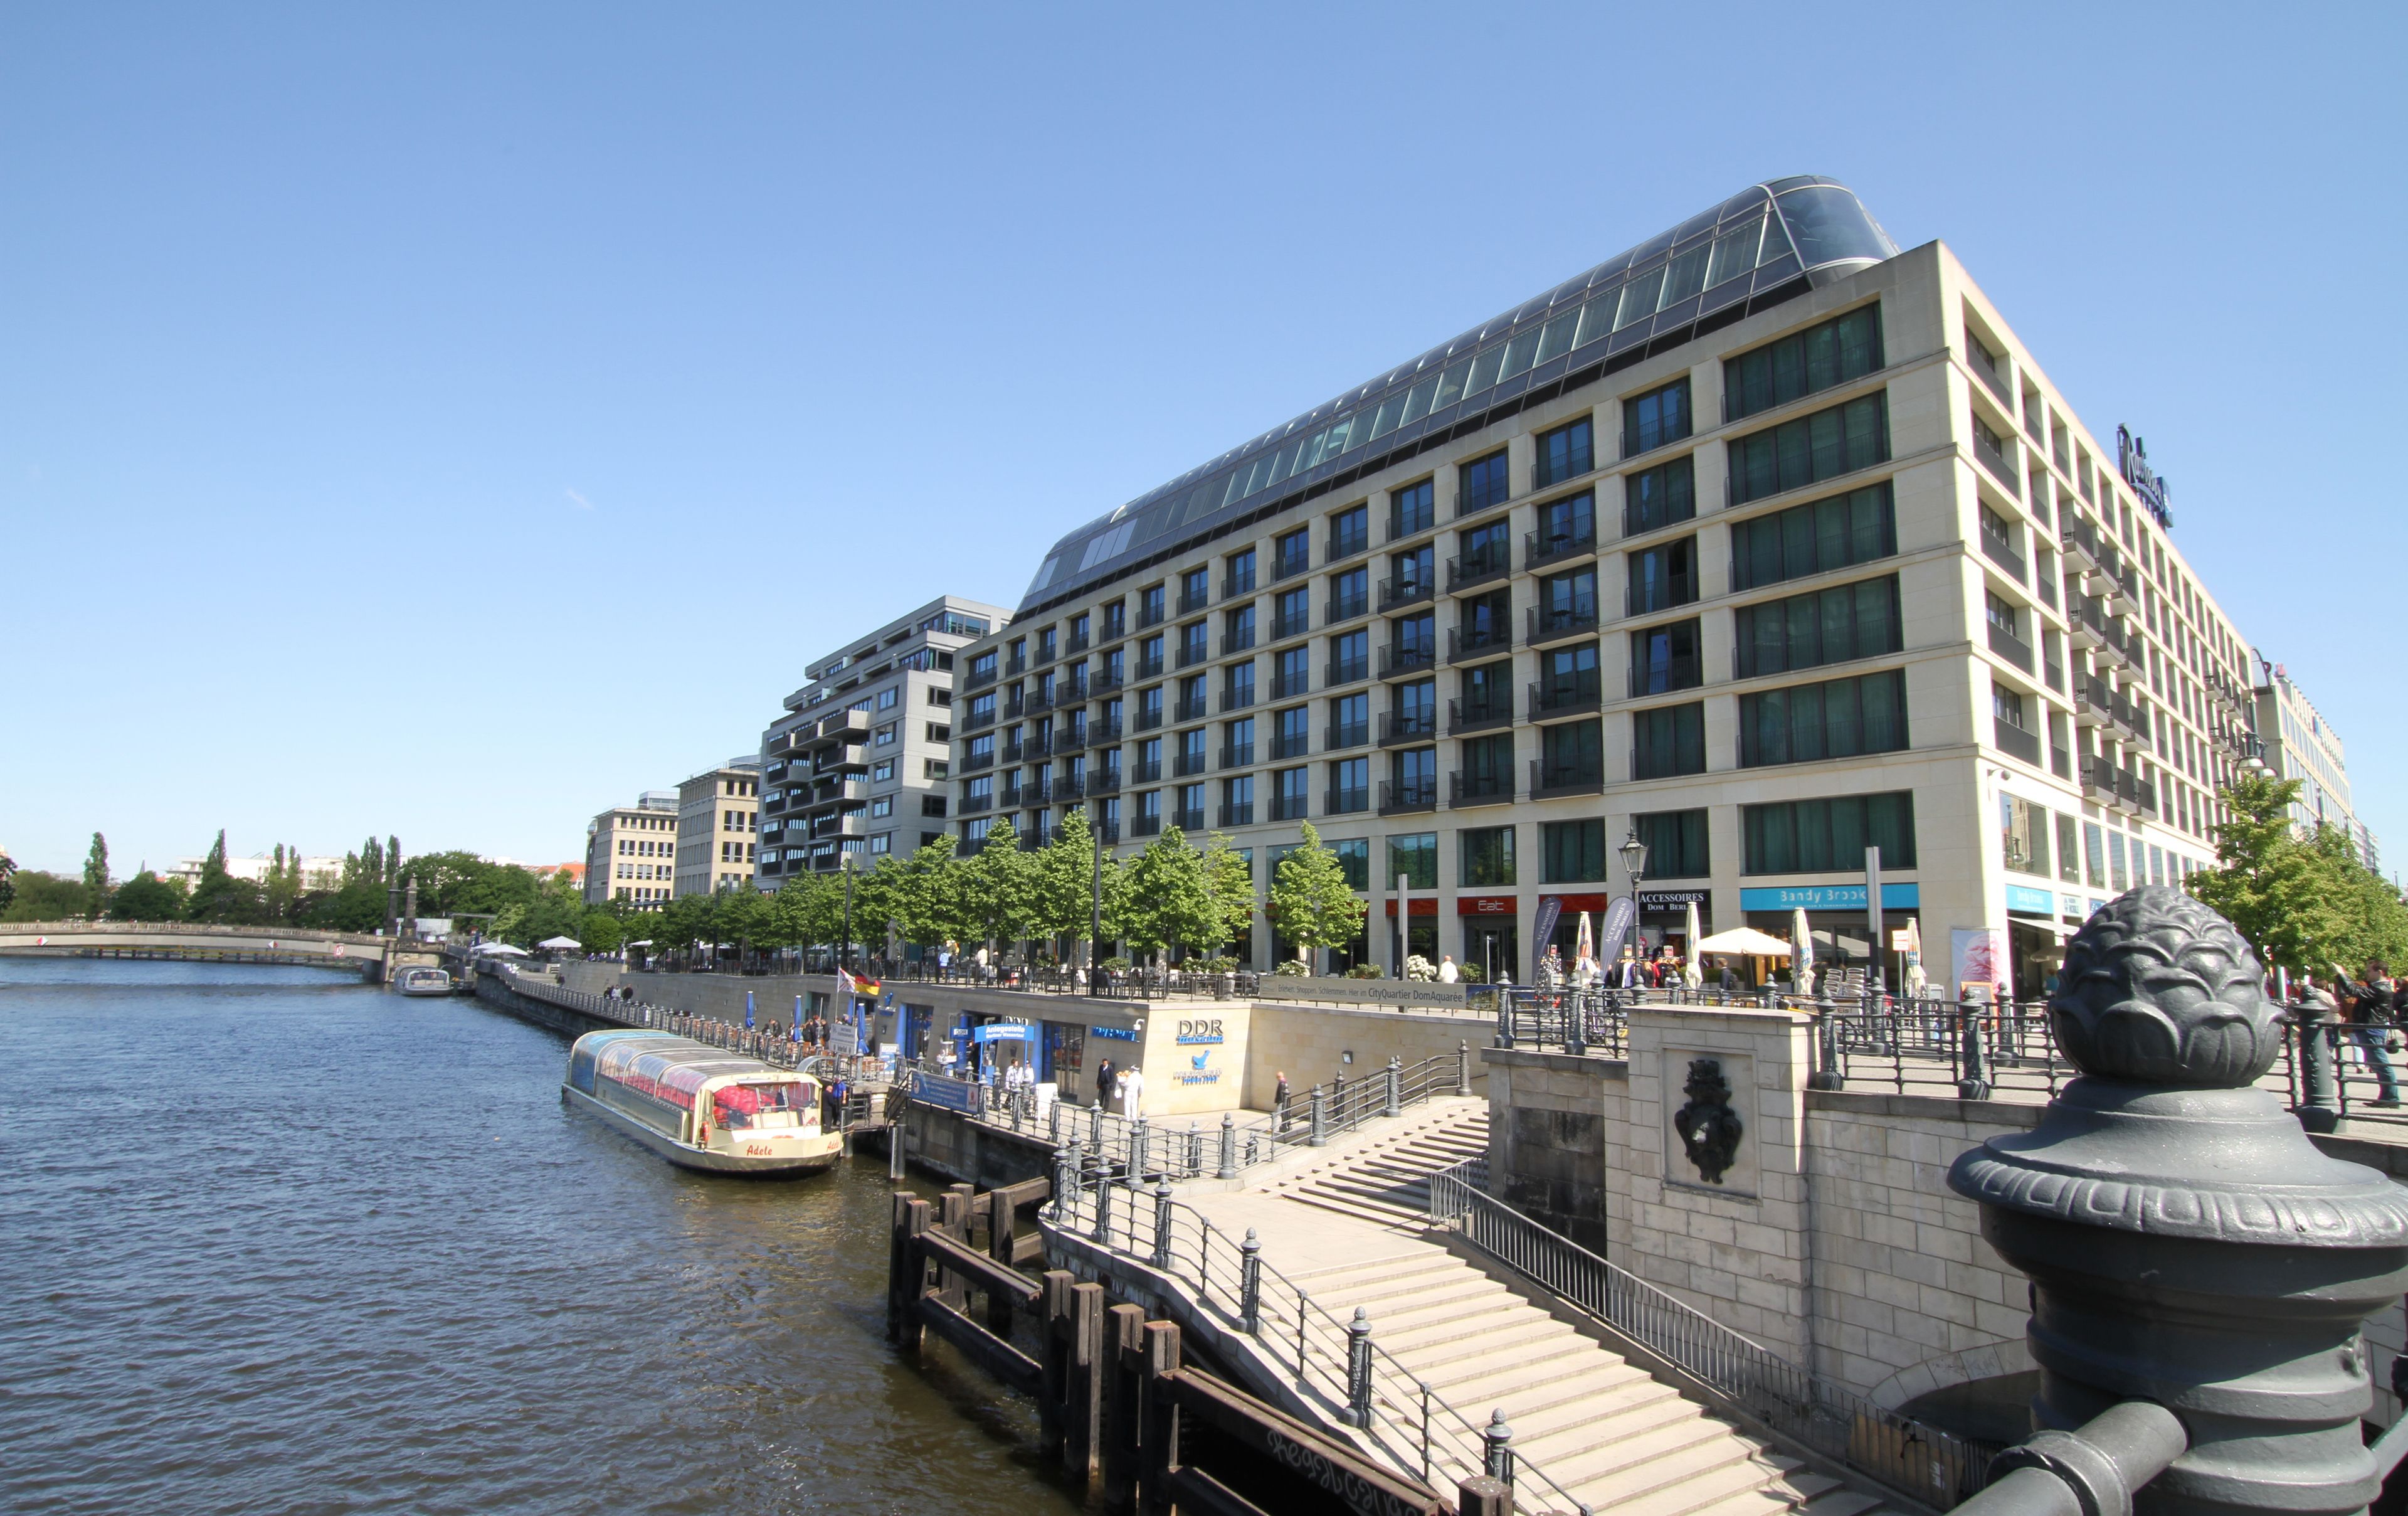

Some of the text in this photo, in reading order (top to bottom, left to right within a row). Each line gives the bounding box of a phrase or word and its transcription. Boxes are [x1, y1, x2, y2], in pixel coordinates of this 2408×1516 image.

[1639, 893, 1704, 903] ACCESSOIRES
[1780, 889, 1867, 903] Bandy Brook
[1478, 899, 1504, 911] Eat
[1605, 903, 1627, 944] ACCESSOIRES
[1349, 988, 1360, 996] Hier
[1368, 988, 1411, 1000] CityQuartier
[1413, 990, 1463, 1004] DomAquarée
[986, 1026, 1026, 1034] Anlegestelle
[1177, 1019, 1223, 1035] DDR
[746, 1145, 773, 1156] Adele
